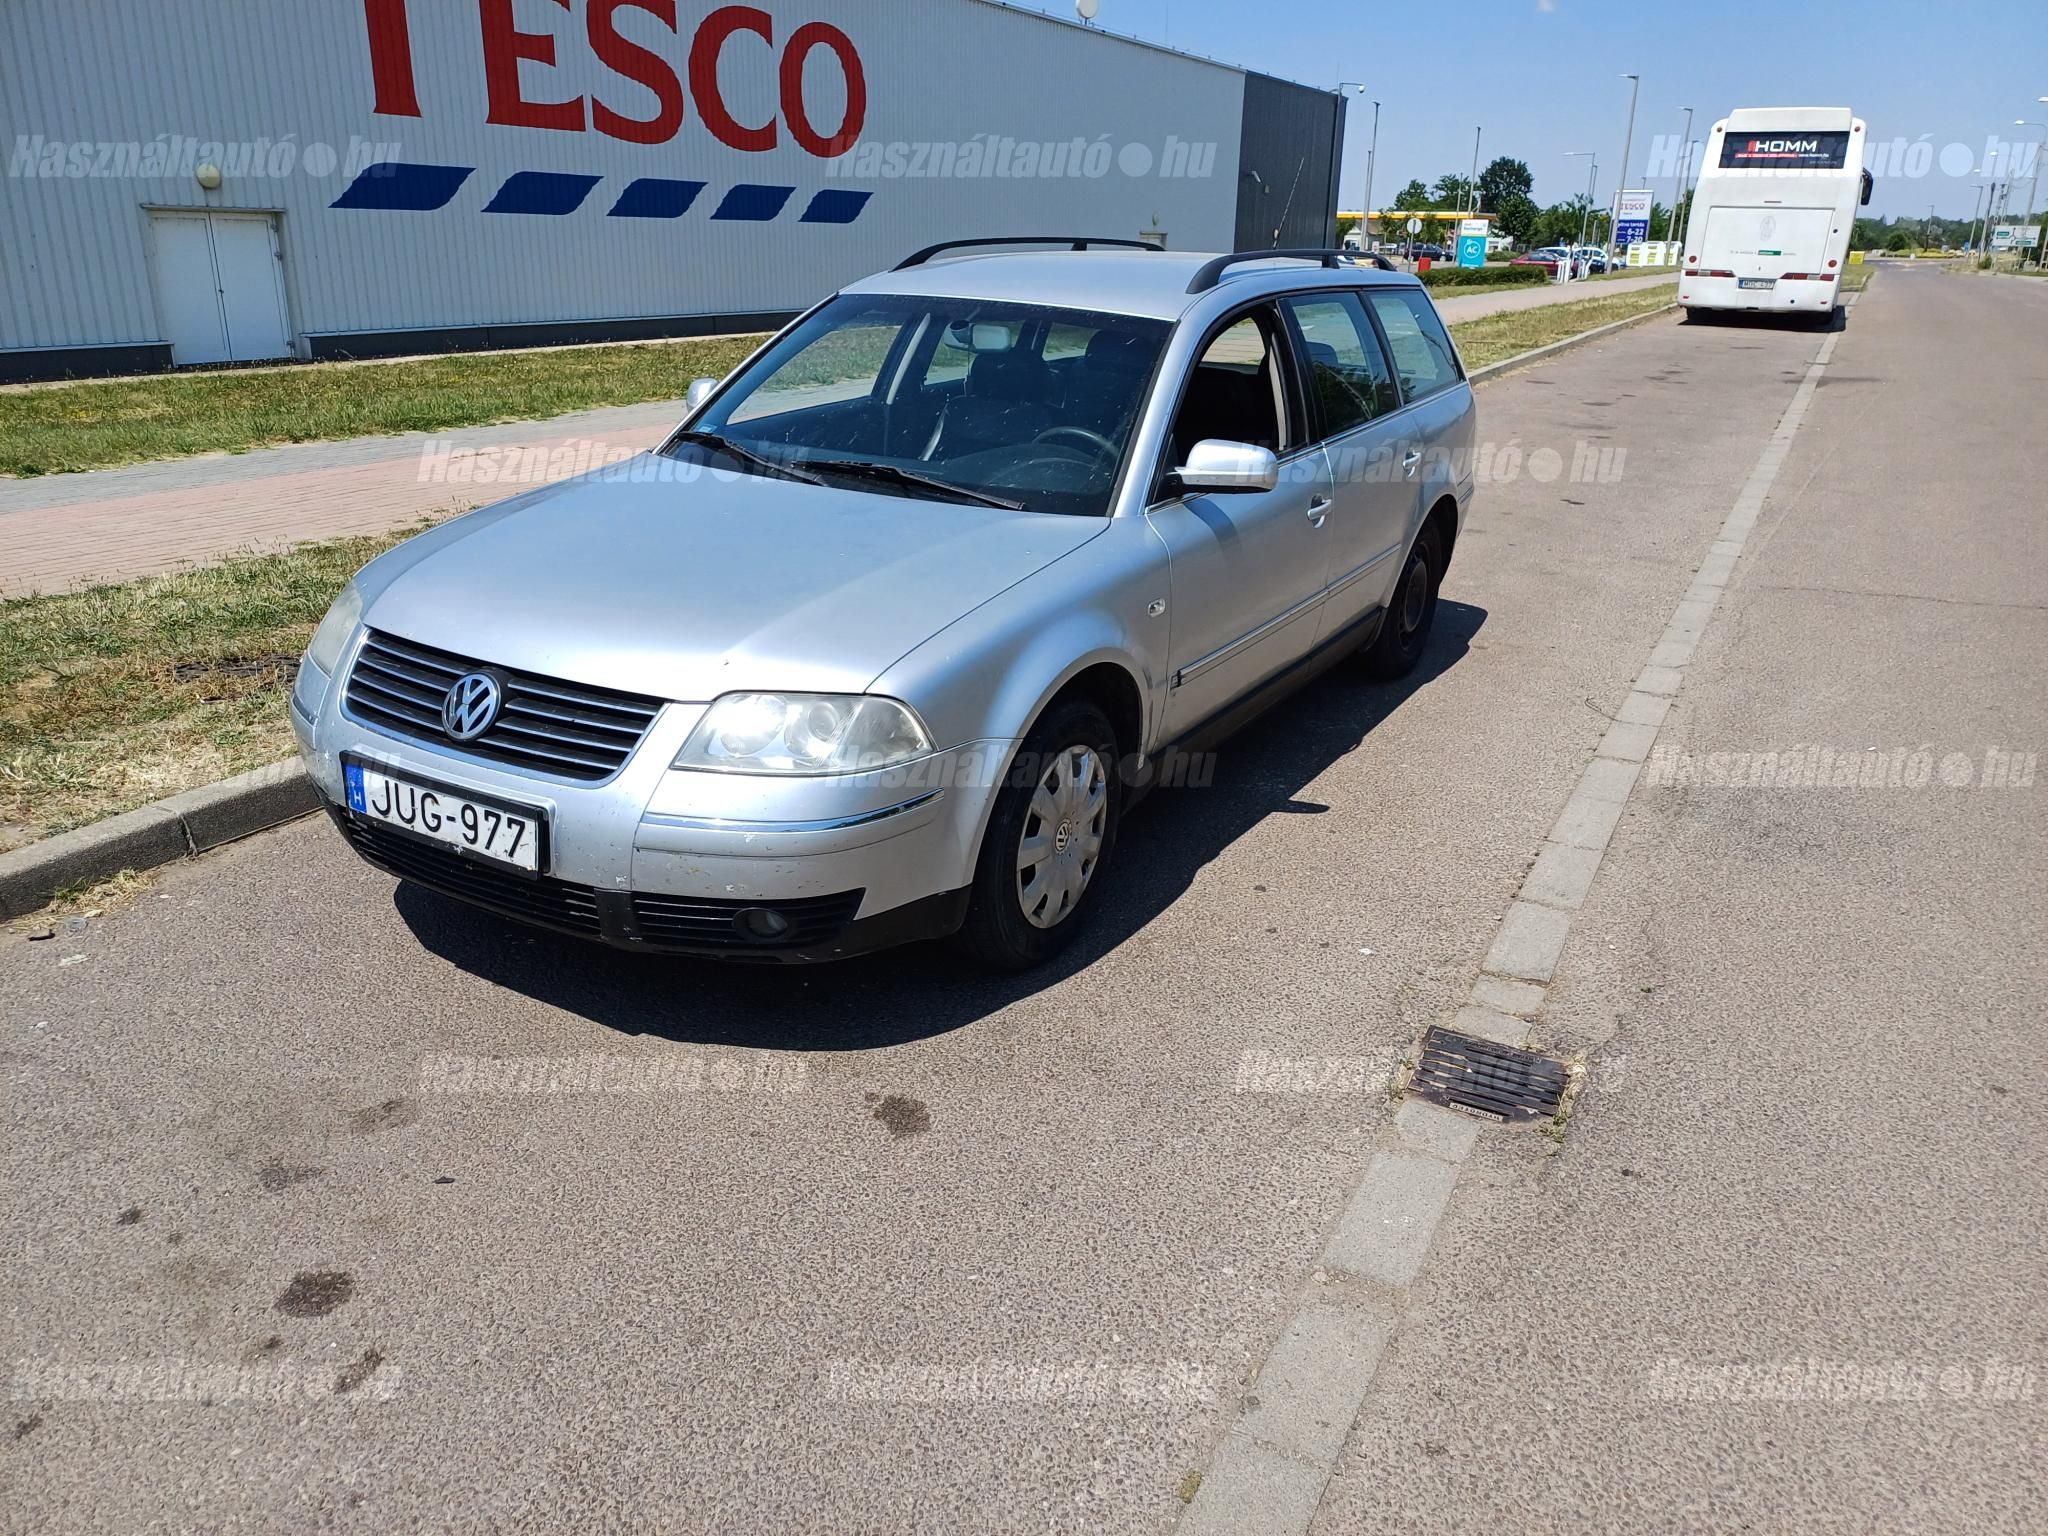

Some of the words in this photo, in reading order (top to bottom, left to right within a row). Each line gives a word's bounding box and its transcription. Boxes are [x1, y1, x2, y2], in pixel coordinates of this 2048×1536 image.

[1754, 140, 1818, 152] HOMM
[1467, 246, 1478, 254] AC
[372, 780, 526, 858] JUG-977
